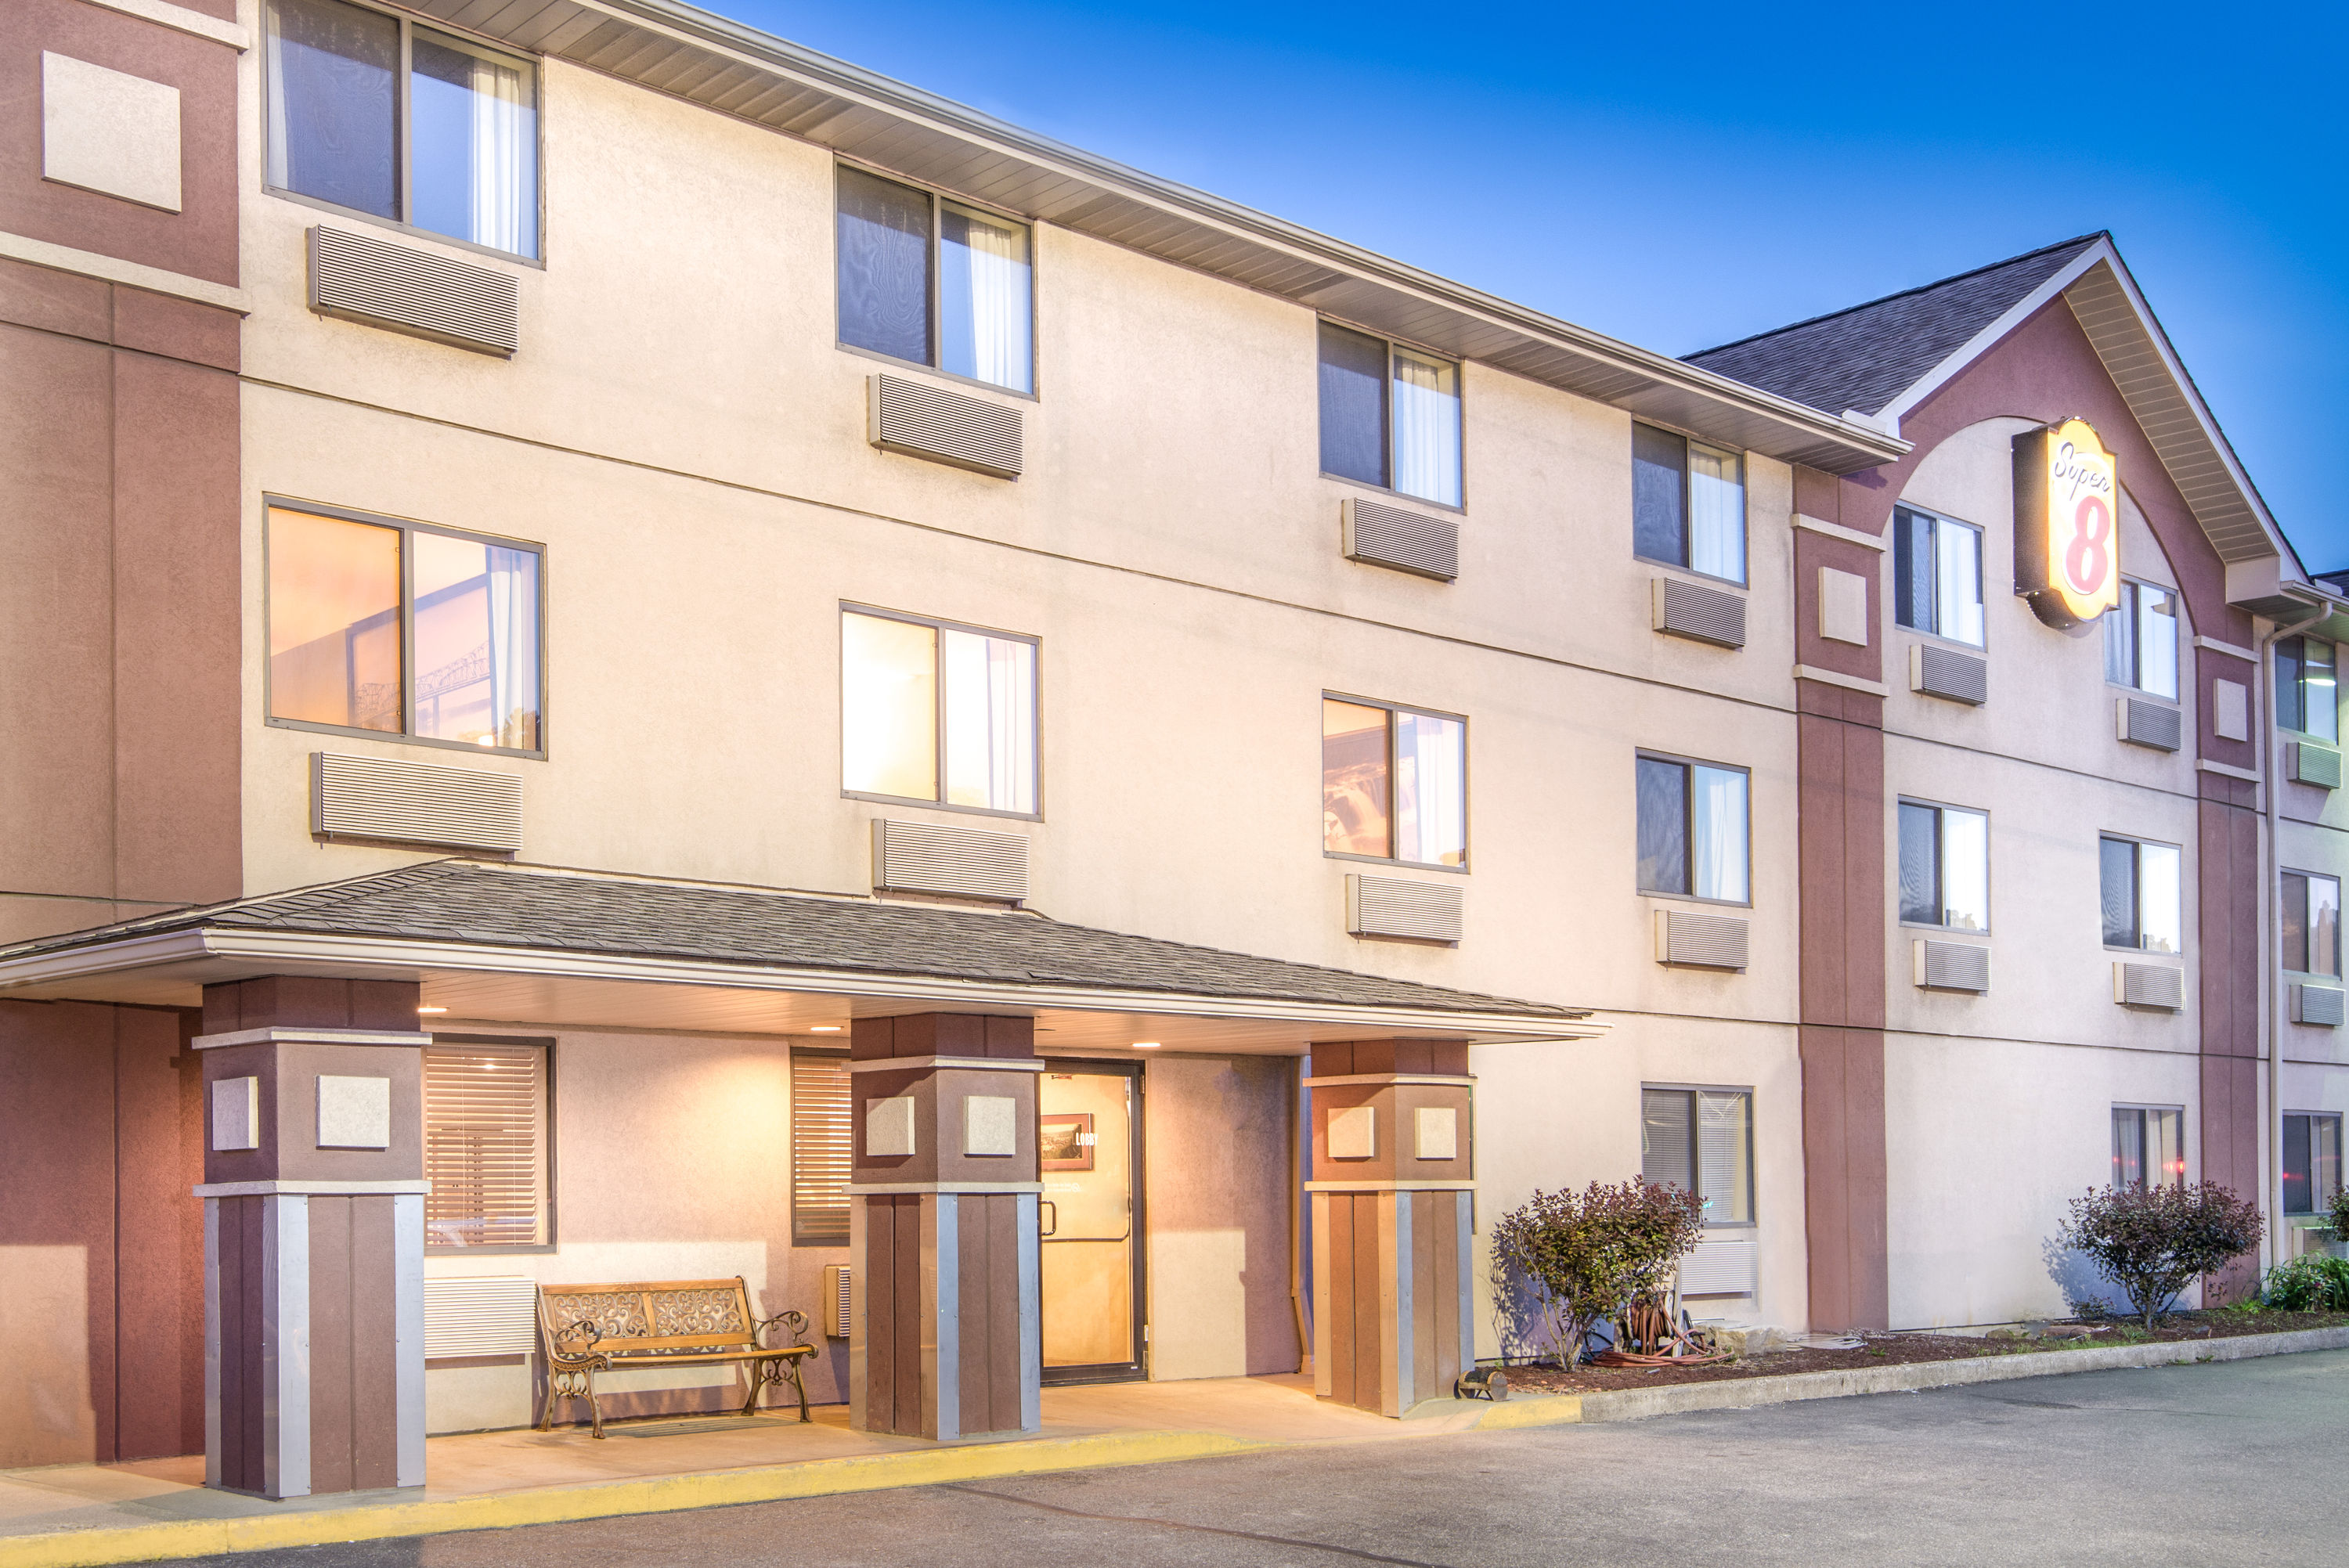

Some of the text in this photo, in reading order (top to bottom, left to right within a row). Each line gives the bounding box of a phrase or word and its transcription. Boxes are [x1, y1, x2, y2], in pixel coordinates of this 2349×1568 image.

[2055, 442, 2110, 501] Super
[2066, 496, 2111, 593] 8
[1075, 1132, 1099, 1146] LOBBY
